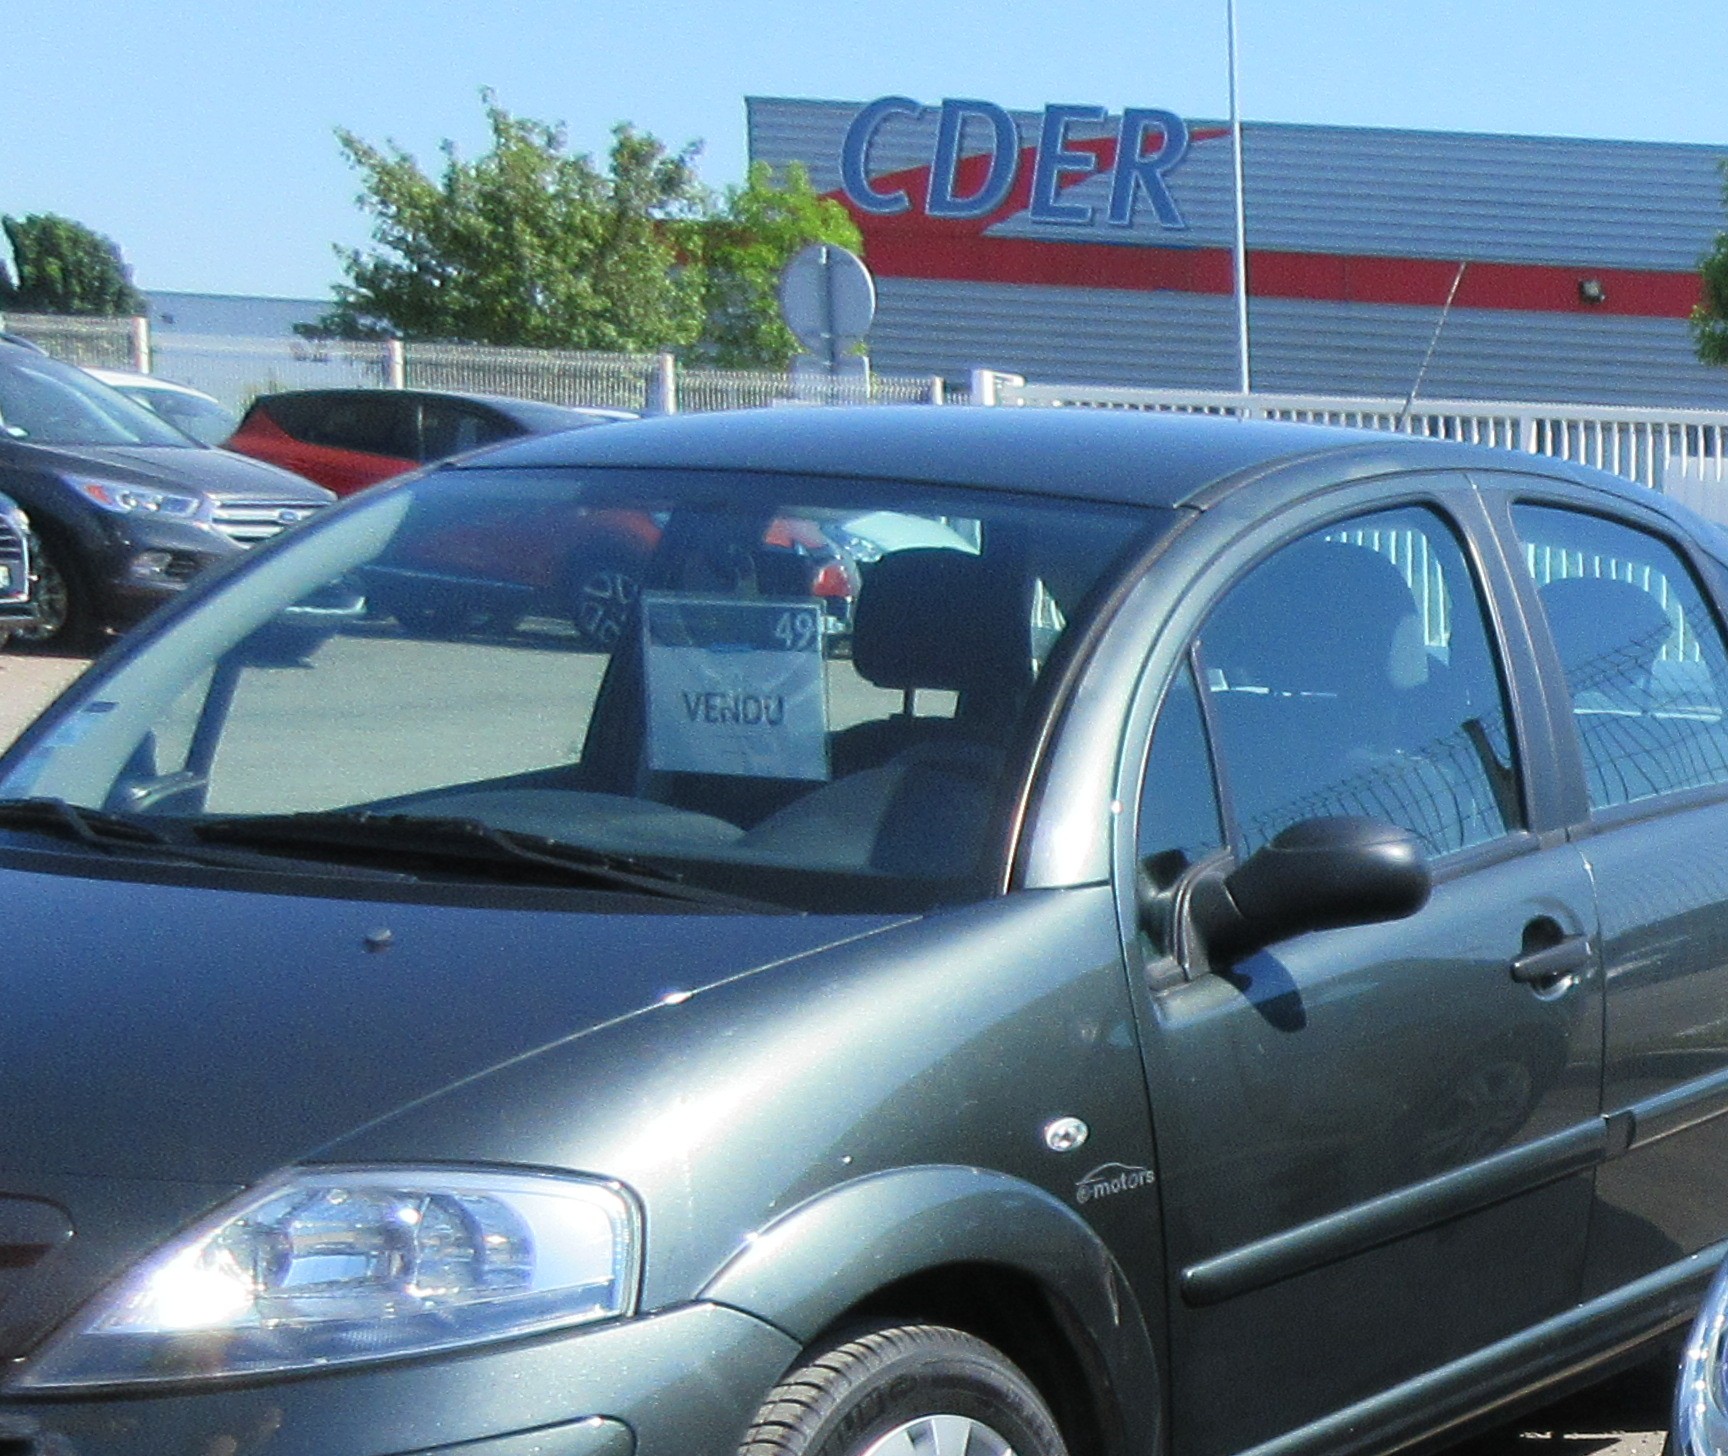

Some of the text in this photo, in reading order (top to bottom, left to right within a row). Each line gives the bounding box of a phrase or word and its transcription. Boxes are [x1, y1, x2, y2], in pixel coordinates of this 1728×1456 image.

[839, 96, 1190, 230] CDER
[775, 612, 815, 648] 49
[682, 690, 784, 726] VENDU
